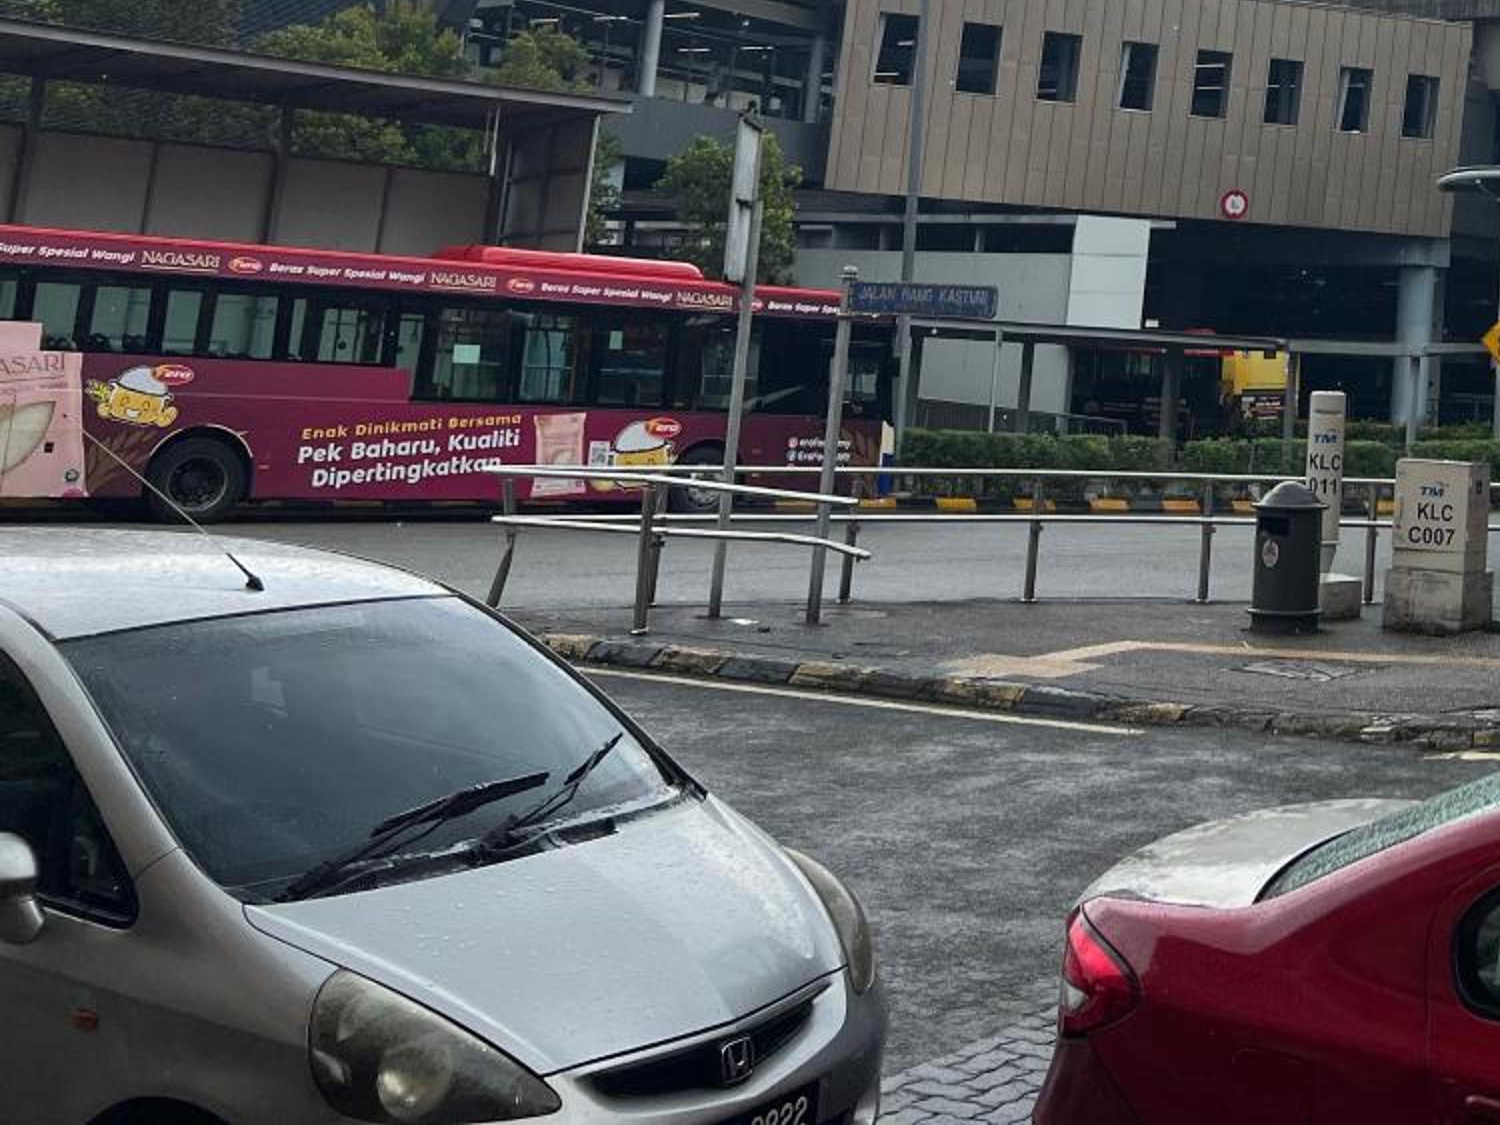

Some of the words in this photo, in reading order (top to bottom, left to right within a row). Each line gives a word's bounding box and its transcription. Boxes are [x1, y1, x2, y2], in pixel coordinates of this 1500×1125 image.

[38, 245, 89, 258] Spesial
[92, 249, 135, 263] Wangi
[141, 251, 220, 267] NAGASARI
[269, 262, 304, 275] Beras
[307, 266, 340, 277] Super
[344, 268, 385, 281] Spesial
[389, 271, 425, 284] Wangi
[430, 272, 497, 288] NAGASARI
[541, 282, 569, 294] Beras
[571, 285, 602, 297] Super
[603, 287, 639, 299] Spesial
[641, 290, 672, 303] Wangi
[676, 291, 733, 307] NAGASARI
[301, 427, 348, 440] Enak
[355, 418, 443, 437] Dinikmati
[448, 414, 522, 429] Bersama
[297, 443, 343, 463] Pek
[351, 438, 441, 460] Baharu,
[448, 428, 521, 452] Kualiti
[1313, 433, 1337, 444] TM
[1309, 453, 1341, 471] KLC
[311, 456, 501, 490] Dipertingkatkan
[1309, 477, 1338, 495] 011
[1420, 485, 1444, 497] TM
[1417, 502, 1453, 522] KLC
[1408, 526, 1456, 545] C007
